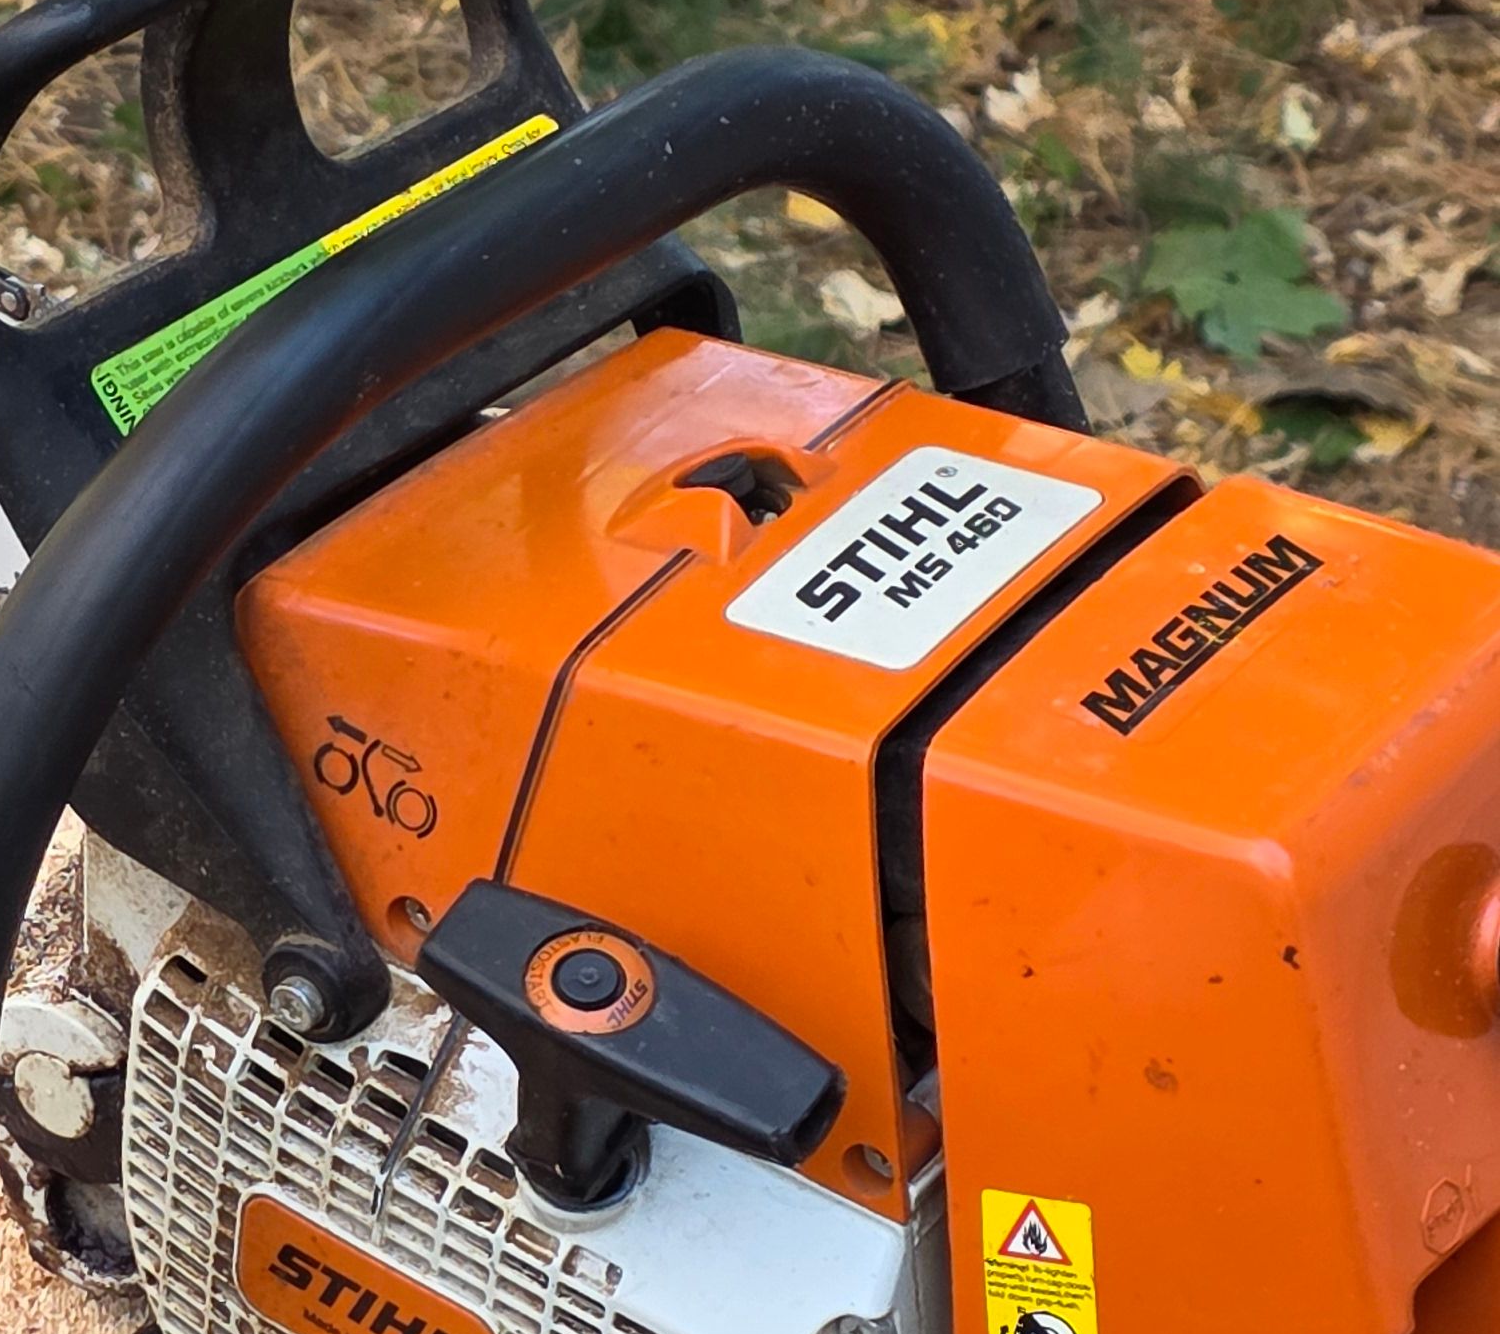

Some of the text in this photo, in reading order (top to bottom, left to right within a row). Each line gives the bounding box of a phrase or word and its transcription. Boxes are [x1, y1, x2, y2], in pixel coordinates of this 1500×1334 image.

[796, 482, 988, 622] STIHL
[884, 496, 1022, 609] MS 460
[1080, 534, 1325, 736] MAGNUM
[607, 979, 649, 1029] STIHL
